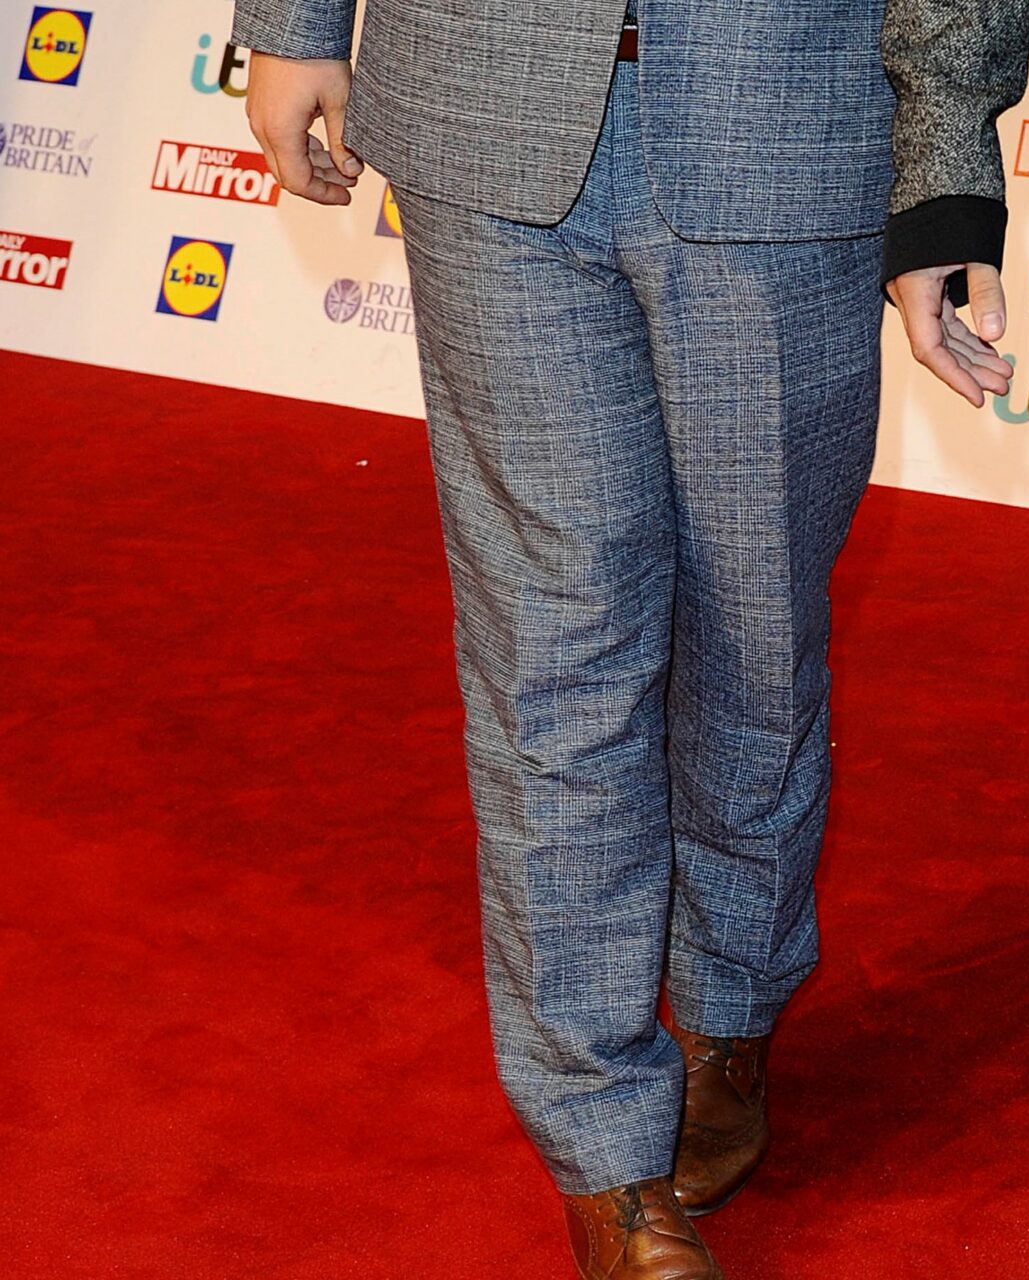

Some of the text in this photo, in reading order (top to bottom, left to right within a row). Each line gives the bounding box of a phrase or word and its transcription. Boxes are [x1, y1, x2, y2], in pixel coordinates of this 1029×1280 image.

[7, 123, 76, 152] PRIDE
[3, 147, 94, 177] BRITAIN
[200, 147, 238, 167] DAILY
[155, 144, 278, 202] Mirror
[0, 233, 26, 250] AILY
[364, 281, 414, 310] PRI
[359, 306, 416, 336] BRIT
